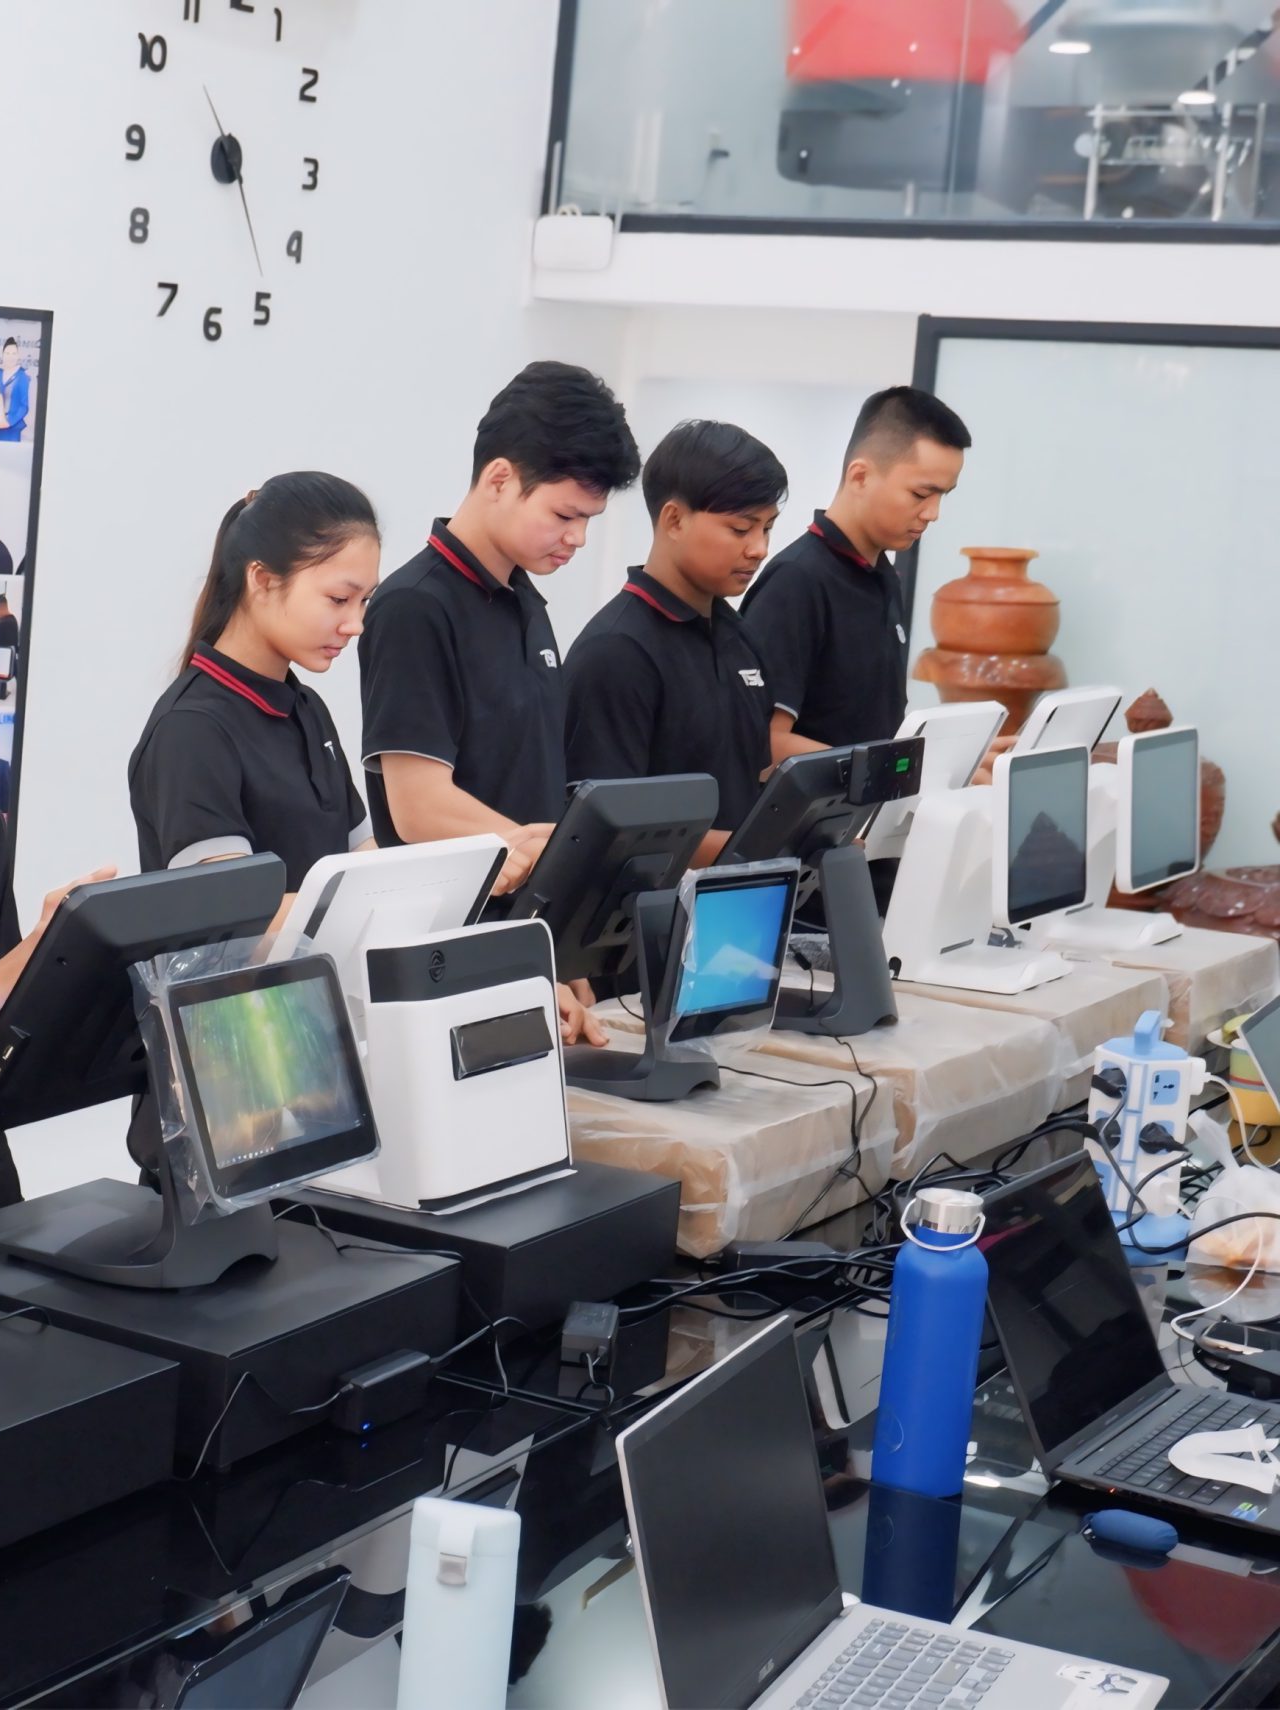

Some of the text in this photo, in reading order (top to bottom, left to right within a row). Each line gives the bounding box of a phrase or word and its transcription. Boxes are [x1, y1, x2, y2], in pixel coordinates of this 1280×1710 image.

[274, 8, 283, 43] 1
[138, 33, 168, 73] 10
[299, 68, 320, 104] 2
[126, 124, 147, 162] 9
[302, 157, 320, 192] 3
[129, 208, 151, 245] 8
[287, 231, 304, 265] 4
[157, 282, 179, 318] 7
[254, 292, 272, 327] 5
[203, 307, 223, 343] 6
